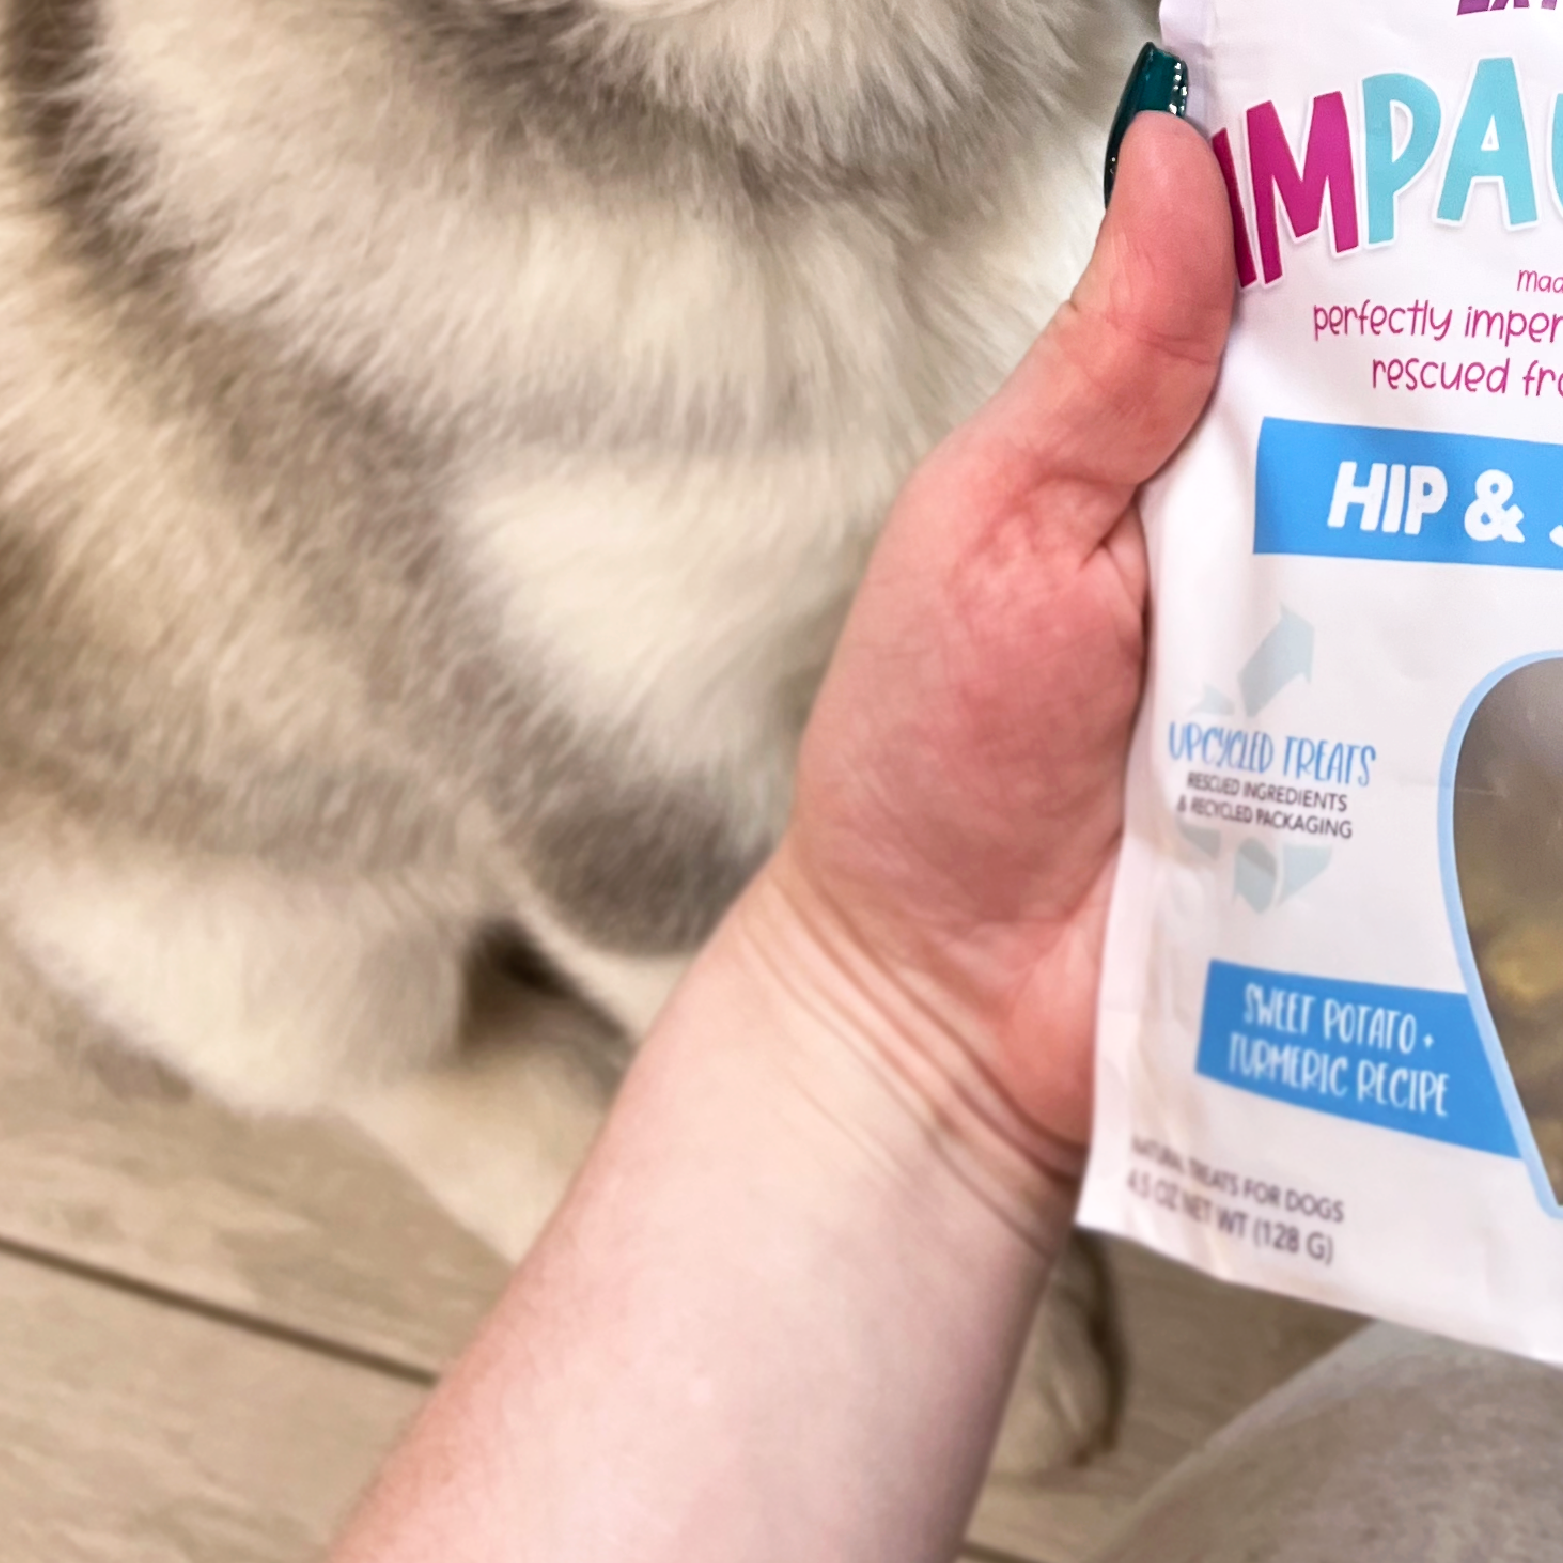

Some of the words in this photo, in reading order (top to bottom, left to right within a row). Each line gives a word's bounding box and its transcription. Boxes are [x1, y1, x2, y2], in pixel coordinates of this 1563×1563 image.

[1313, 299, 1452, 341] perfectly
[1372, 357, 1510, 394] rescued
[1327, 461, 1449, 535] HIP
[1464, 468, 1526, 543] &
[1168, 721, 1274, 775] UPCYCLED
[1283, 735, 1377, 787] TREATS
[1186, 771, 1241, 797] RESCUED
[1243, 781, 1348, 813] INGREDIENTS
[1190, 795, 1253, 824] RECYCLED
[1255, 808, 1353, 839] PACKAGING
[1244, 983, 1315, 1035] SWEET
[1323, 998, 1418, 1055] POTATO
[1229, 1032, 1348, 1098] TURMERIC
[1357, 1059, 1449, 1118] RECIPE
[1188, 1155, 1238, 1197] TREATS
[1244, 1177, 1281, 1209] FOR
[1285, 1188, 1345, 1224] DOGS
[1217, 1206, 1248, 1236] WT
[1253, 1216, 1300, 1254] (128
[1306, 1231, 1335, 1266] G)
